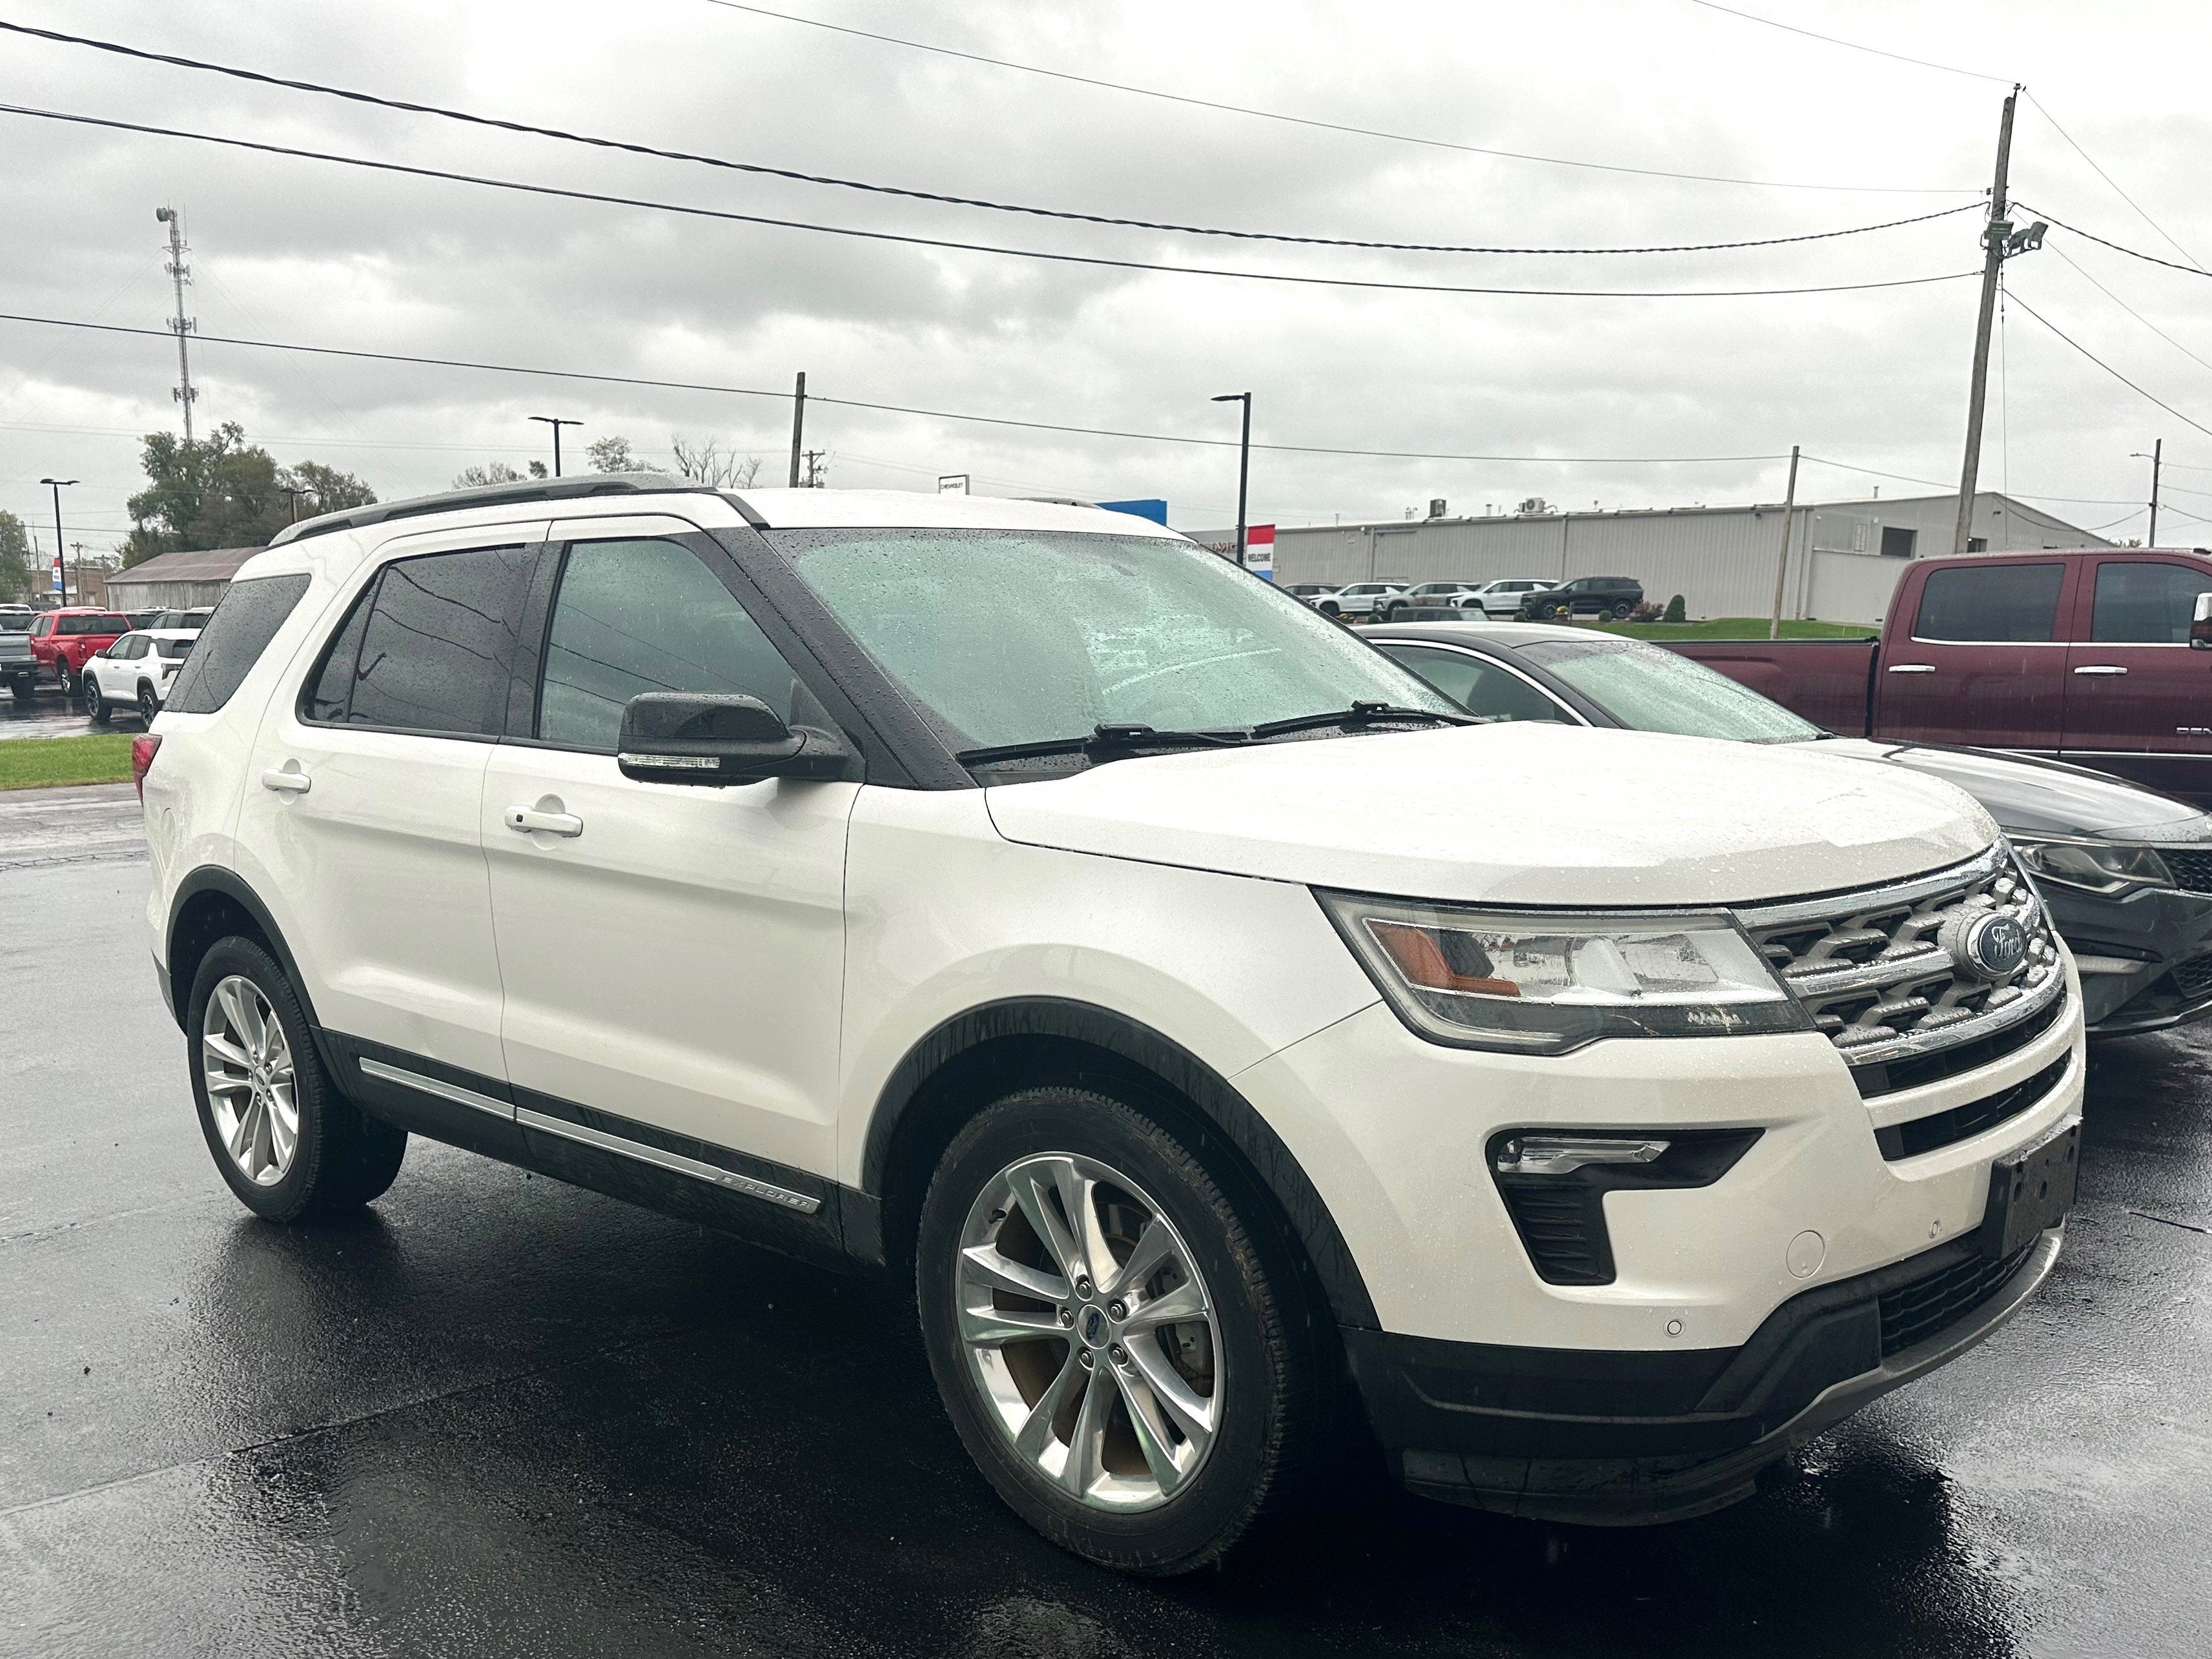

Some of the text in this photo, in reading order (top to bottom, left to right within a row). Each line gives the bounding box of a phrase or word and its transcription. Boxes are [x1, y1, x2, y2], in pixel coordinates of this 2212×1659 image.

[1248, 553, 1271, 562] WELCOME
[1991, 924, 2023, 959] Ford
[722, 1176, 810, 1209] EXPLORER
